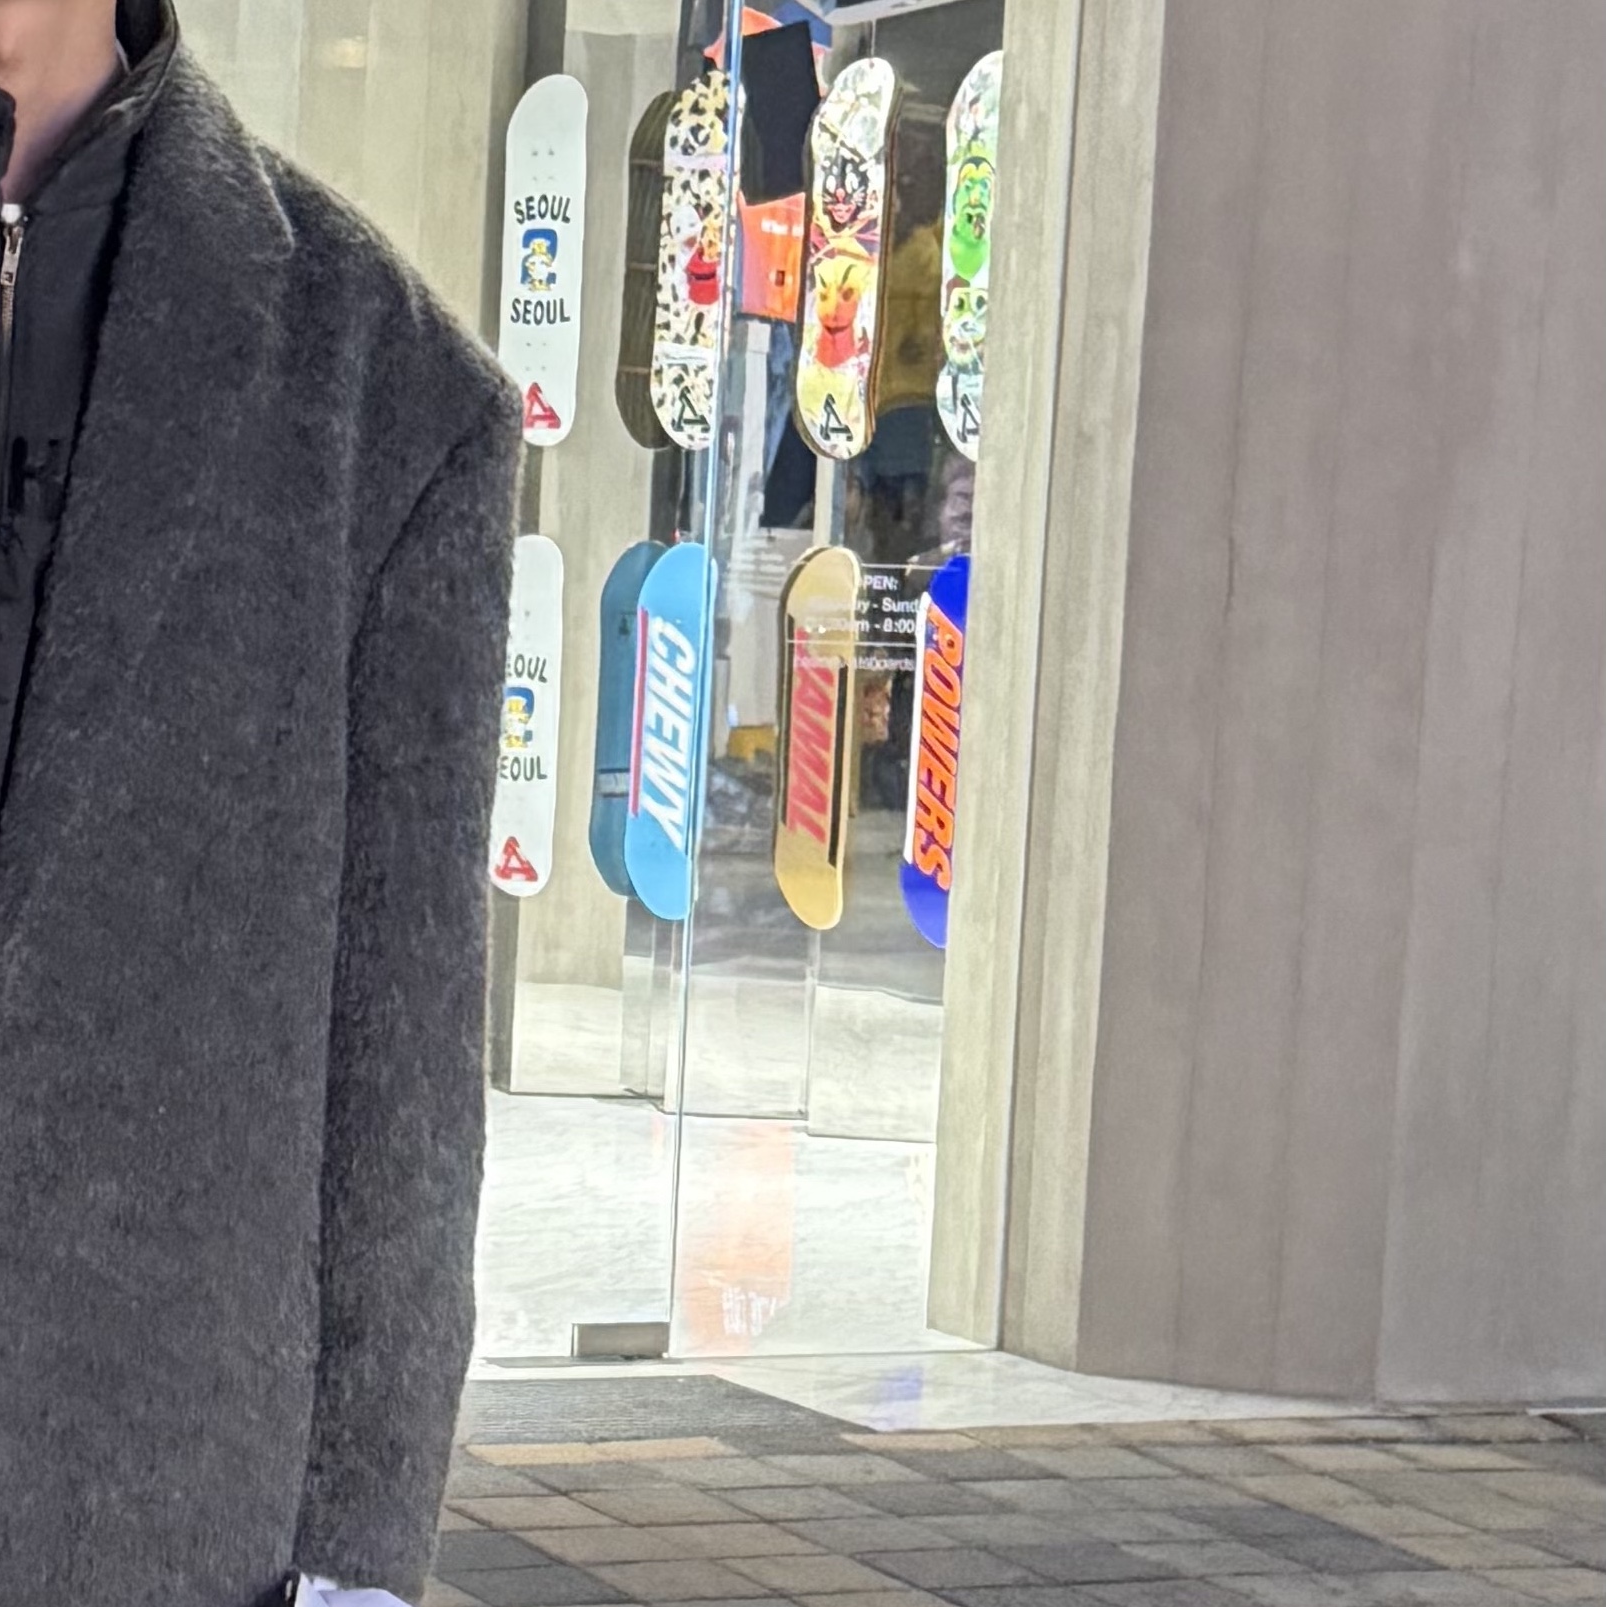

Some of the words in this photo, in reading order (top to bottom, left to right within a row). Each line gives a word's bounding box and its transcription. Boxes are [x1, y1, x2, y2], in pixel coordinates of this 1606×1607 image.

[514, 194, 571, 225] SEOUL
[510, 298, 571, 326] SEOUL
[859, 574, 899, 591] PEN:
[883, 617, 915, 633] 8:00
[507, 653, 548, 684] OUL
[640, 616, 696, 855] CHEWY
[786, 626, 835, 844] JAMAL
[914, 603, 963, 891] POWERS
[500, 755, 548, 781] EOUL
